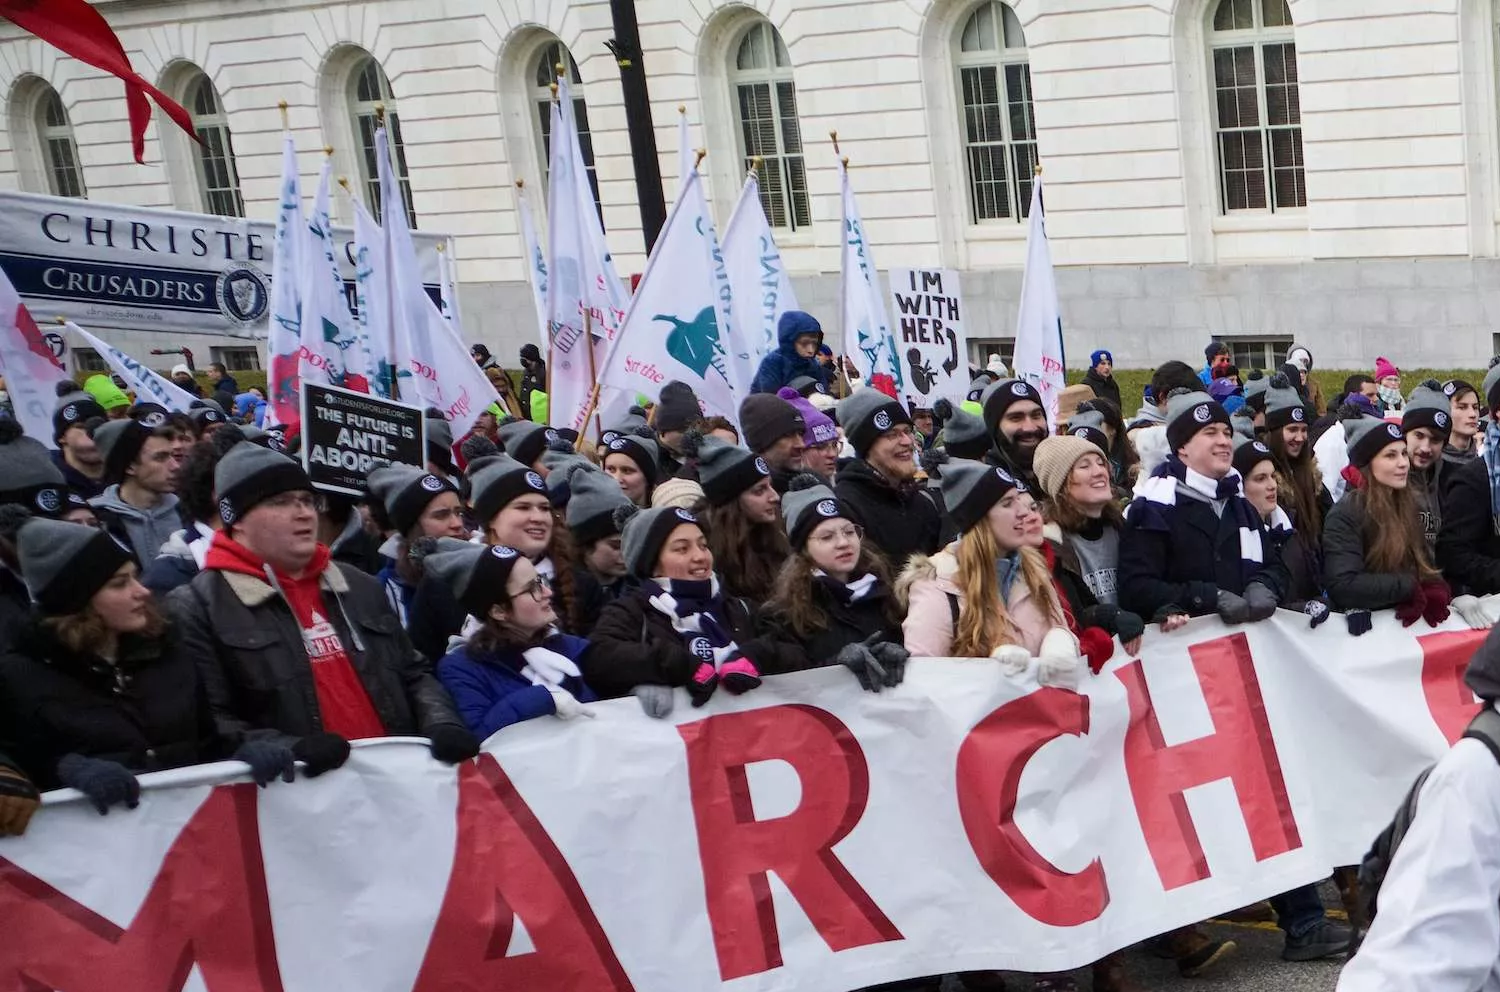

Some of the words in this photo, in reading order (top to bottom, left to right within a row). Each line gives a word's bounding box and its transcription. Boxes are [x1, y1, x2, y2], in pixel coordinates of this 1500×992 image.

[41, 213, 263, 260] CHRISTE
[43, 267, 205, 301] CRUSADERS
[895, 293, 960, 321] WITH
[900, 318, 945, 345] HER
[315, 406, 342, 423] THE
[346, 412, 398, 435] FUTURE
[401, 425, 415, 439] IS
[336, 427, 396, 455] ANTI-
[310, 444, 390, 473] ABOR
